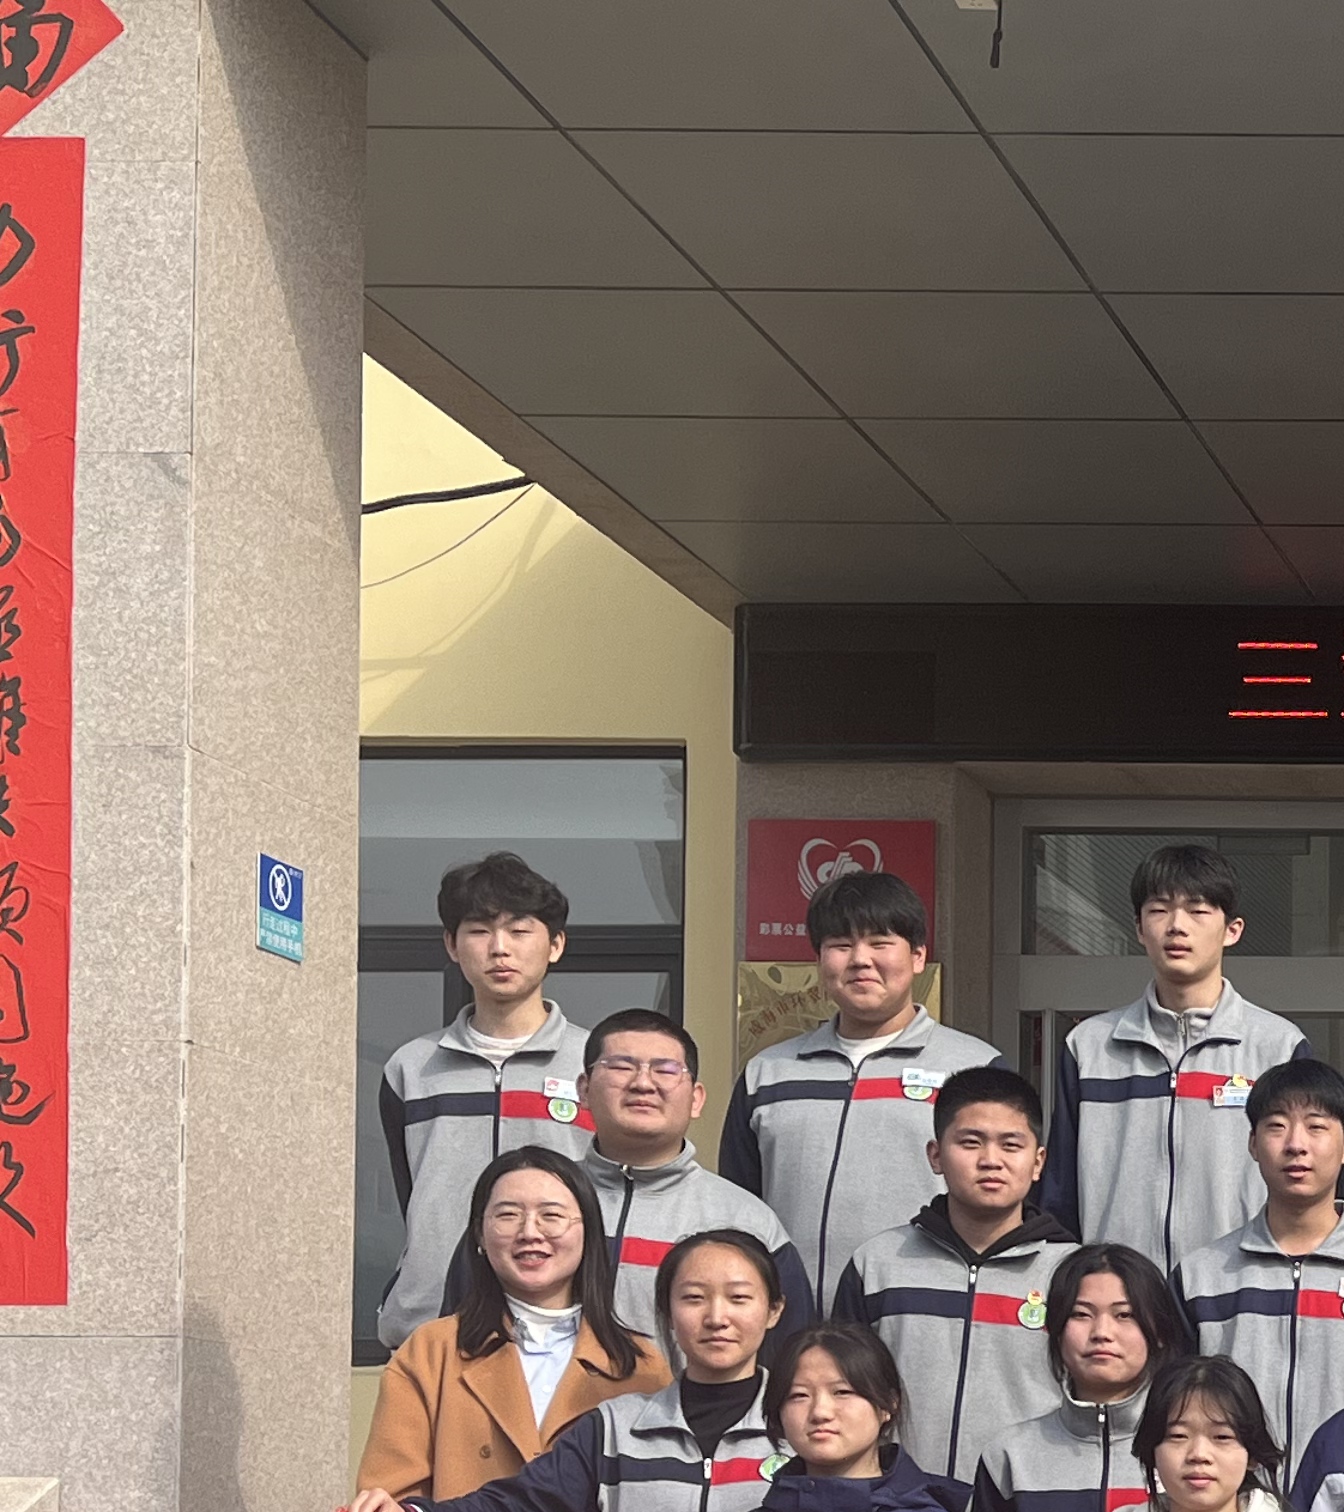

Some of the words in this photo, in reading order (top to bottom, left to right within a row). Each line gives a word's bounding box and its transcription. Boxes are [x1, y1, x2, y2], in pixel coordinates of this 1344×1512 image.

[748, 985, 828, 1036] 威海市环翠
